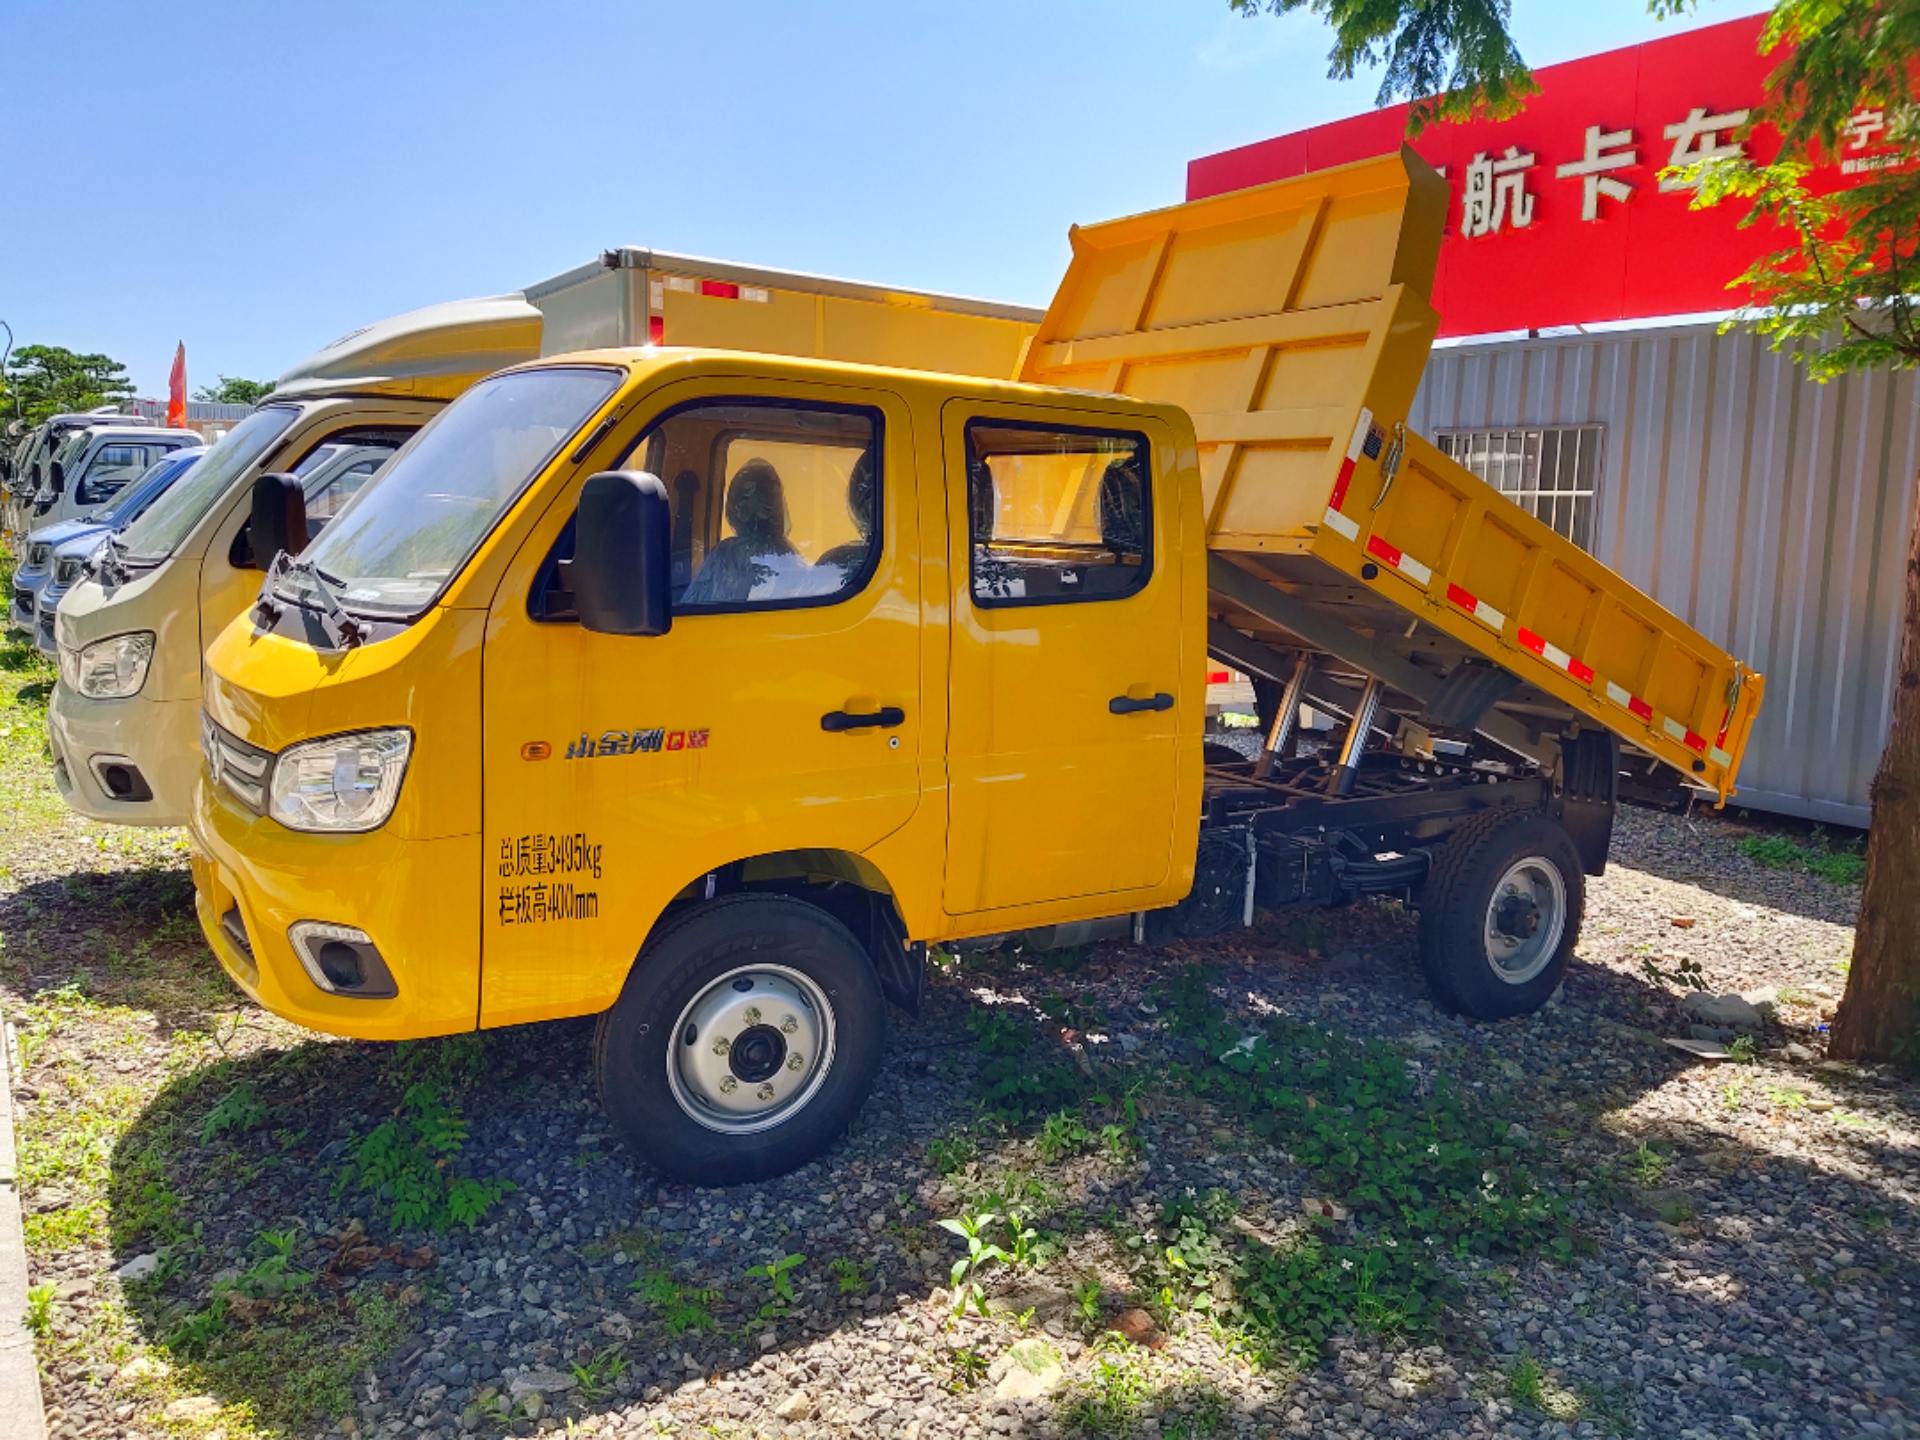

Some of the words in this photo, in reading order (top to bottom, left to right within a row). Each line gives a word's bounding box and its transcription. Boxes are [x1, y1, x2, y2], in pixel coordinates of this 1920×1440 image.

[1440, 106, 1751, 240] 航卡车
[499, 832, 603, 880] 总质量3495kg
[499, 881, 599, 927] 栏板高400mm
